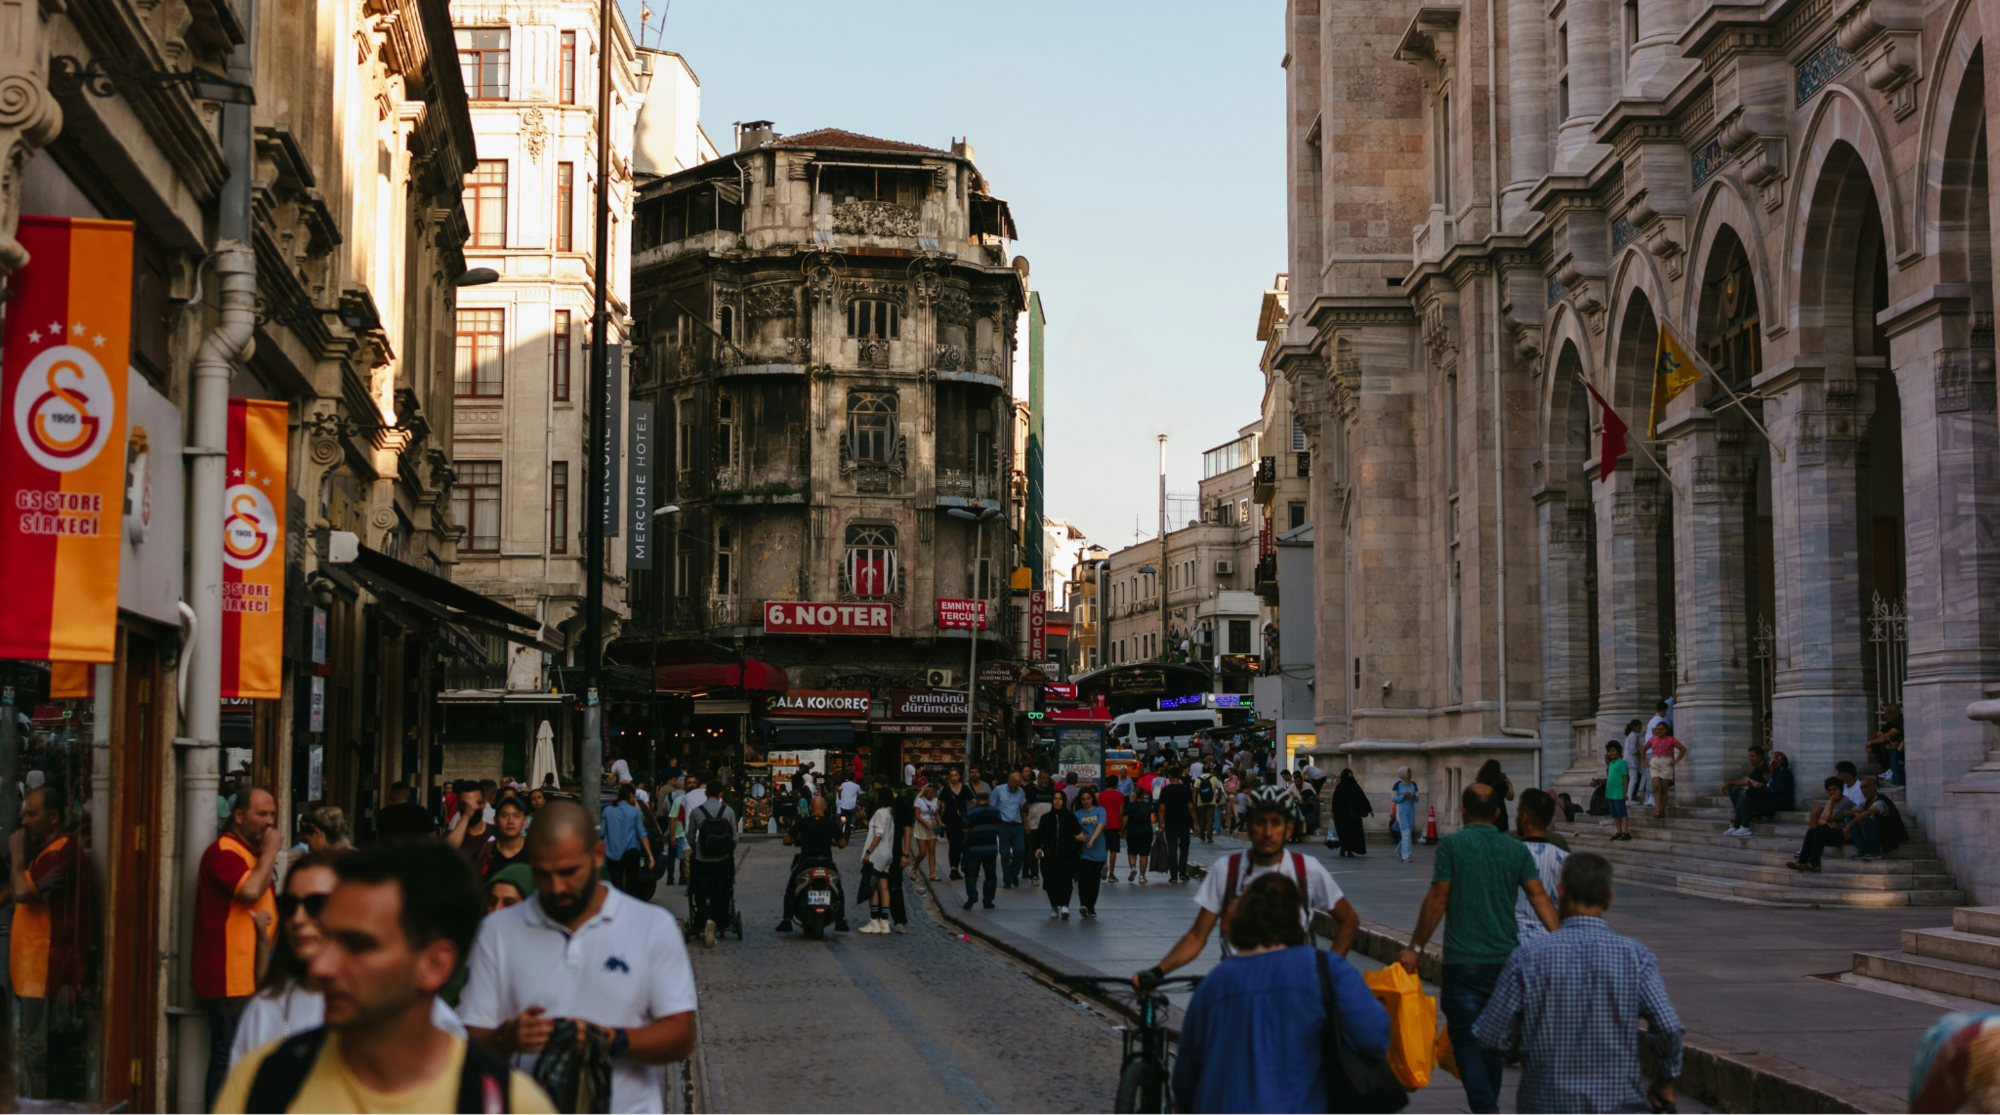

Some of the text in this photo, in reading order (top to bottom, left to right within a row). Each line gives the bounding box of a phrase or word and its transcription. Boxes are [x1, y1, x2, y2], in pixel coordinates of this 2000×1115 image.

[51, 413, 77, 425] 1905
[635, 412, 647, 559] MERCURE HOTEL
[16, 489, 102, 513] GS STORE
[20, 511, 101, 535] SİRKECİ
[232, 583, 271, 598] STORE
[222, 596, 270, 614] İRKECİ
[807, 696, 868, 713] KOKOREÇ
[909, 693, 965, 703] eminönü
